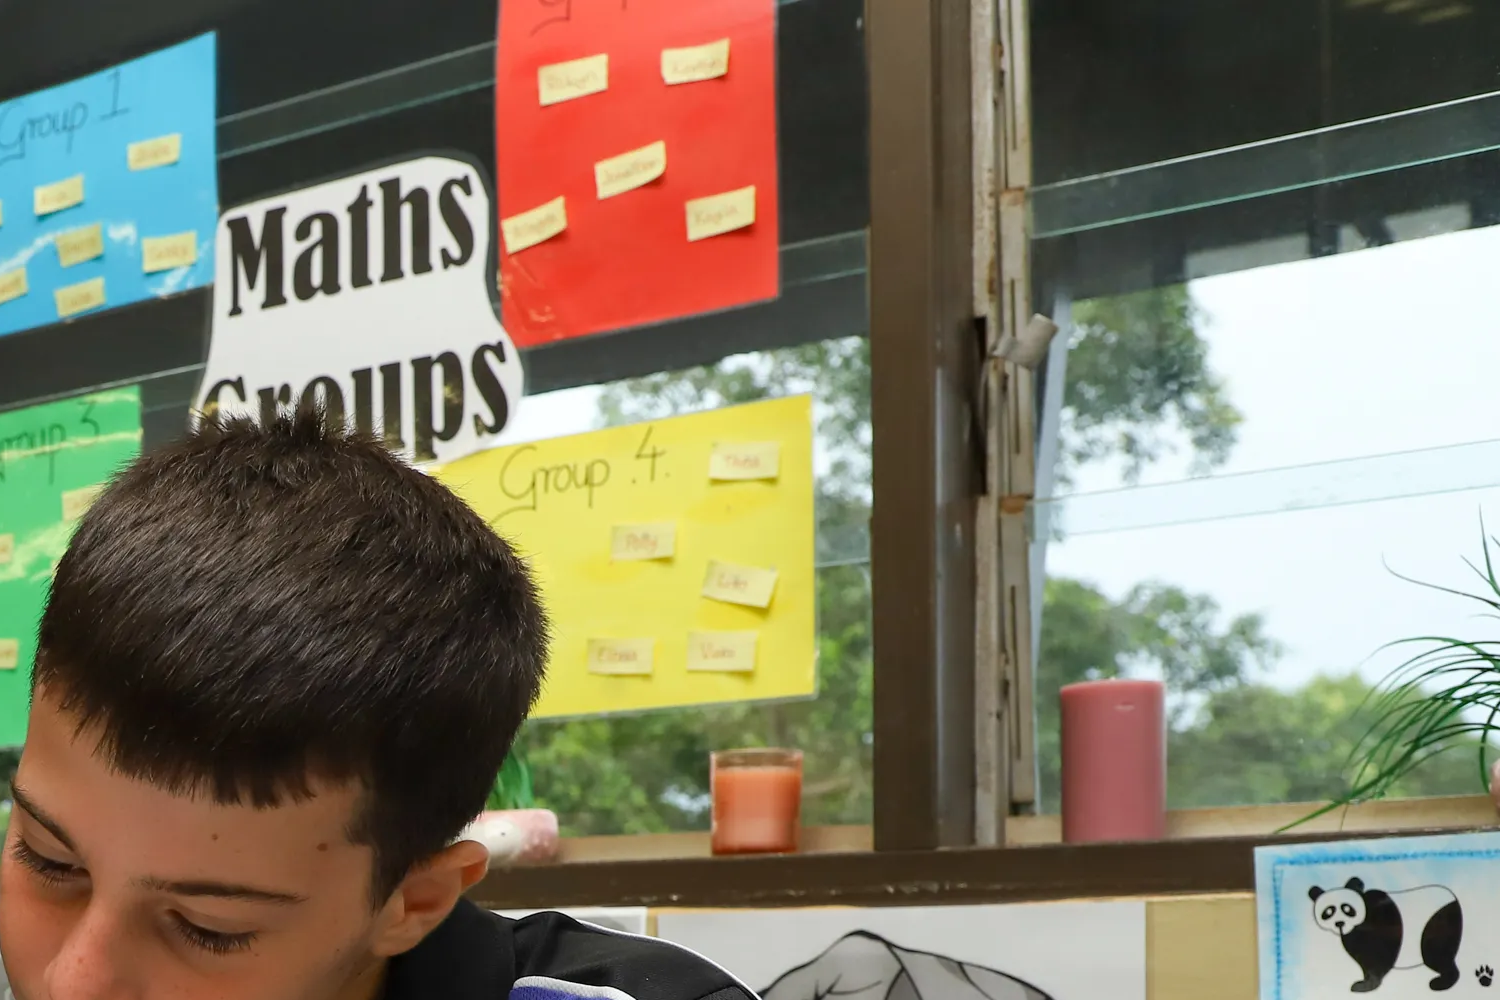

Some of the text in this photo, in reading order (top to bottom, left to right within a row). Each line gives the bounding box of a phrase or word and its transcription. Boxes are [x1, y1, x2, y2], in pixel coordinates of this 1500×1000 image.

[100, 70, 131, 119] 1
[226, 174, 475, 317] Maths
[79, 400, 101, 436] 3
[490, 444, 611, 524] Group
